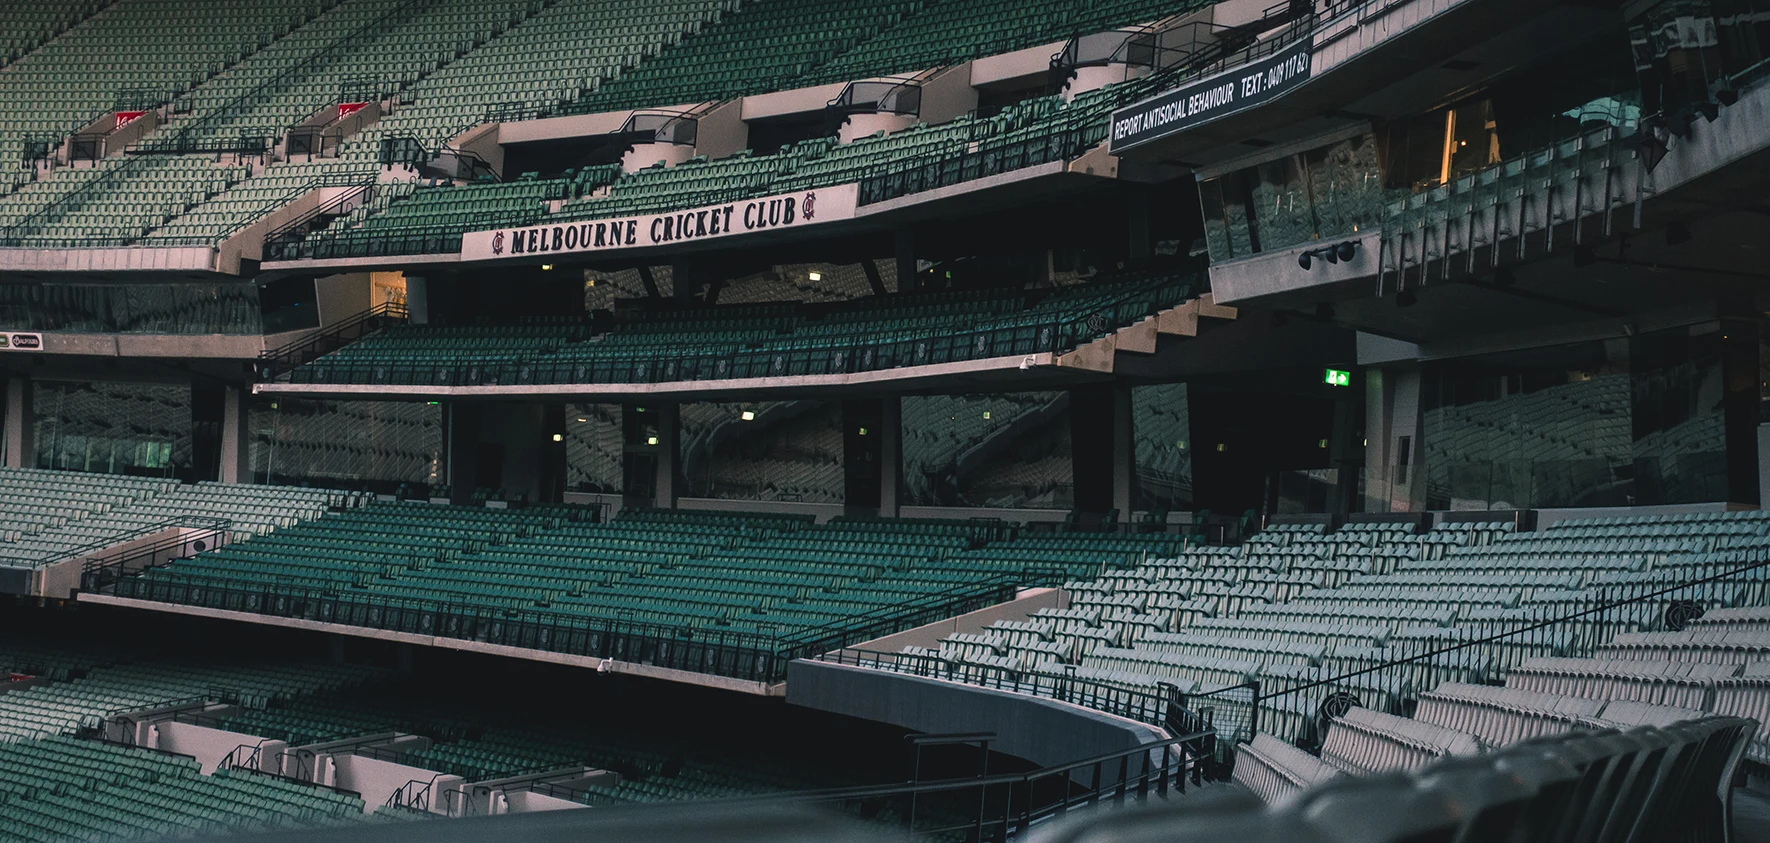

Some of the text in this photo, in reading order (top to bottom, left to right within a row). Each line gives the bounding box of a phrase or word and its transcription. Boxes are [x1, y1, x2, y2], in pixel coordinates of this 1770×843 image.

[1114, 113, 1143, 140] REPORT
[1142, 98, 1187, 131] ANTISOCIAL
[1188, 82, 1234, 116] BEHAVIOUR
[1241, 72, 1263, 98] TEXT
[511, 220, 638, 254] MELBOURNE
[650, 204, 734, 243] CRICKET
[744, 197, 796, 230] CLUB
